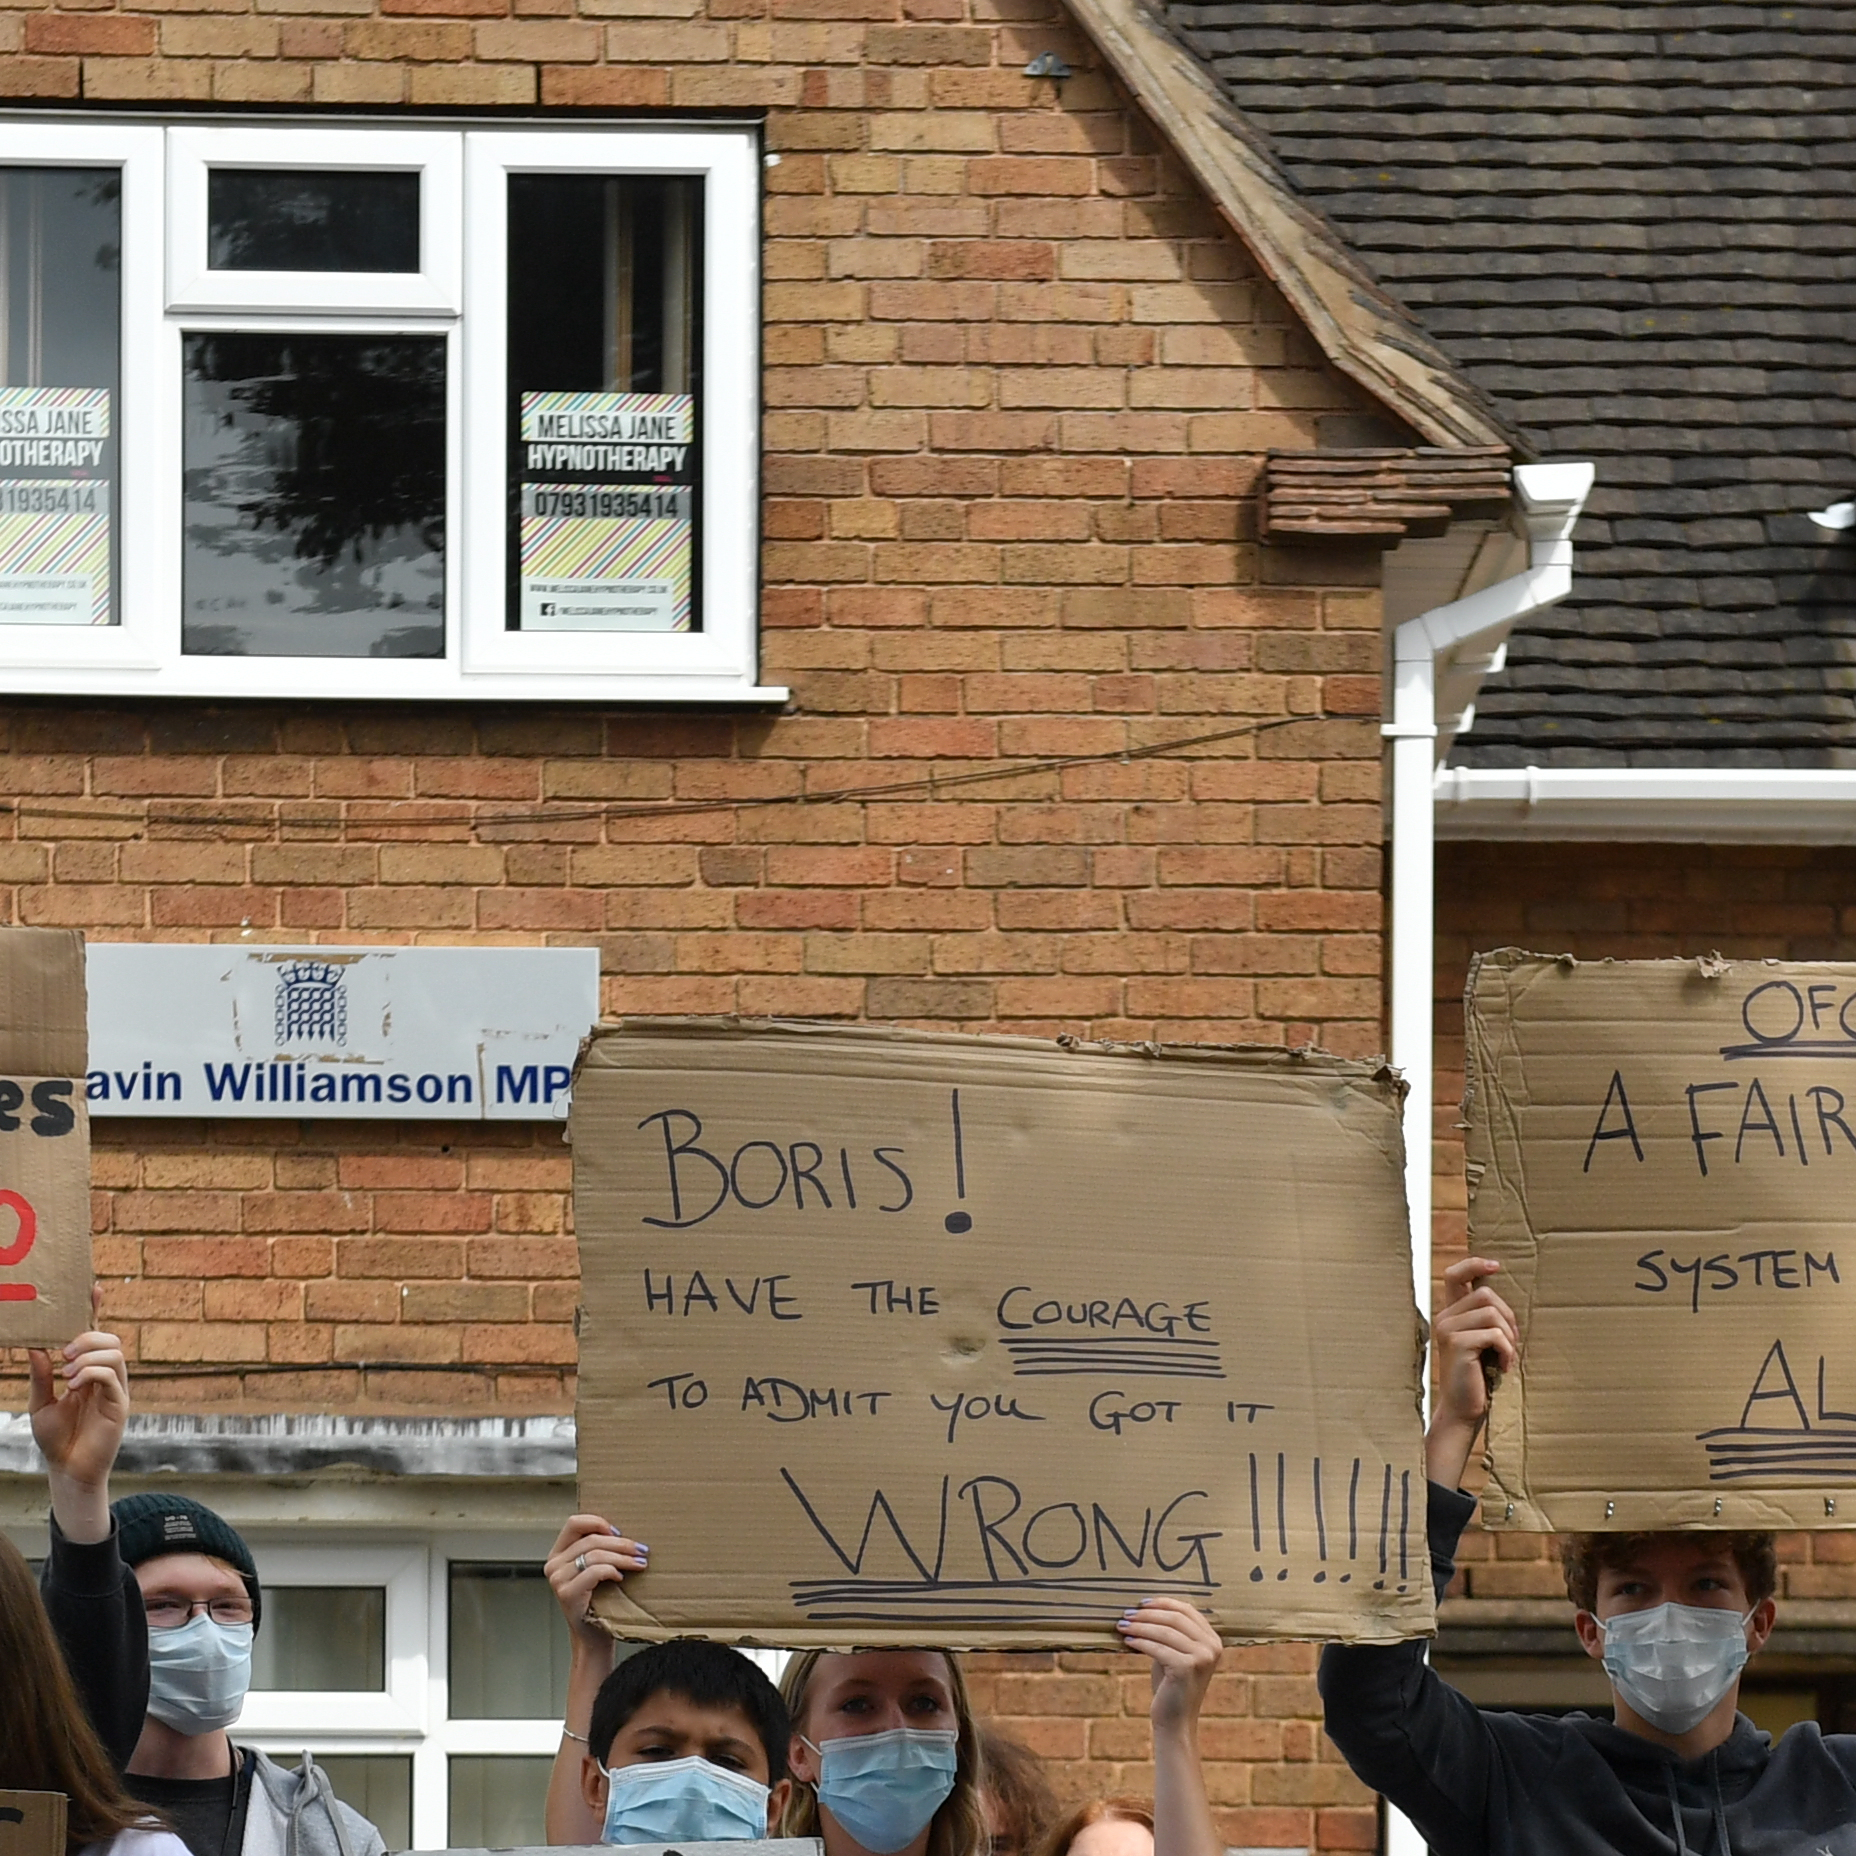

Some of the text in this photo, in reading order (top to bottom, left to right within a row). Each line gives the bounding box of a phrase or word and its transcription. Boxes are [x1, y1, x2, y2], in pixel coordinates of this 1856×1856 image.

[44, 411, 93, 435] JANE
[538, 414, 676, 440] MELISSA JANE
[528, 444, 687, 472] HYPNOTHERAPY
[534, 492, 679, 517] 07931935414
[86, 1061, 571, 1103] avin Williamson MP
[1583, 1069, 1644, 1172] A
[1635, 1248, 1841, 1313] SYSTEM
[643, 1268, 1213, 1337] HAVE THE COURAGE
[648, 1372, 709, 1411] TO
[742, 1376, 892, 1423] ADMIT
[1089, 1390, 1183, 1436] GOT
[1227, 1402, 1276, 1424] IT
